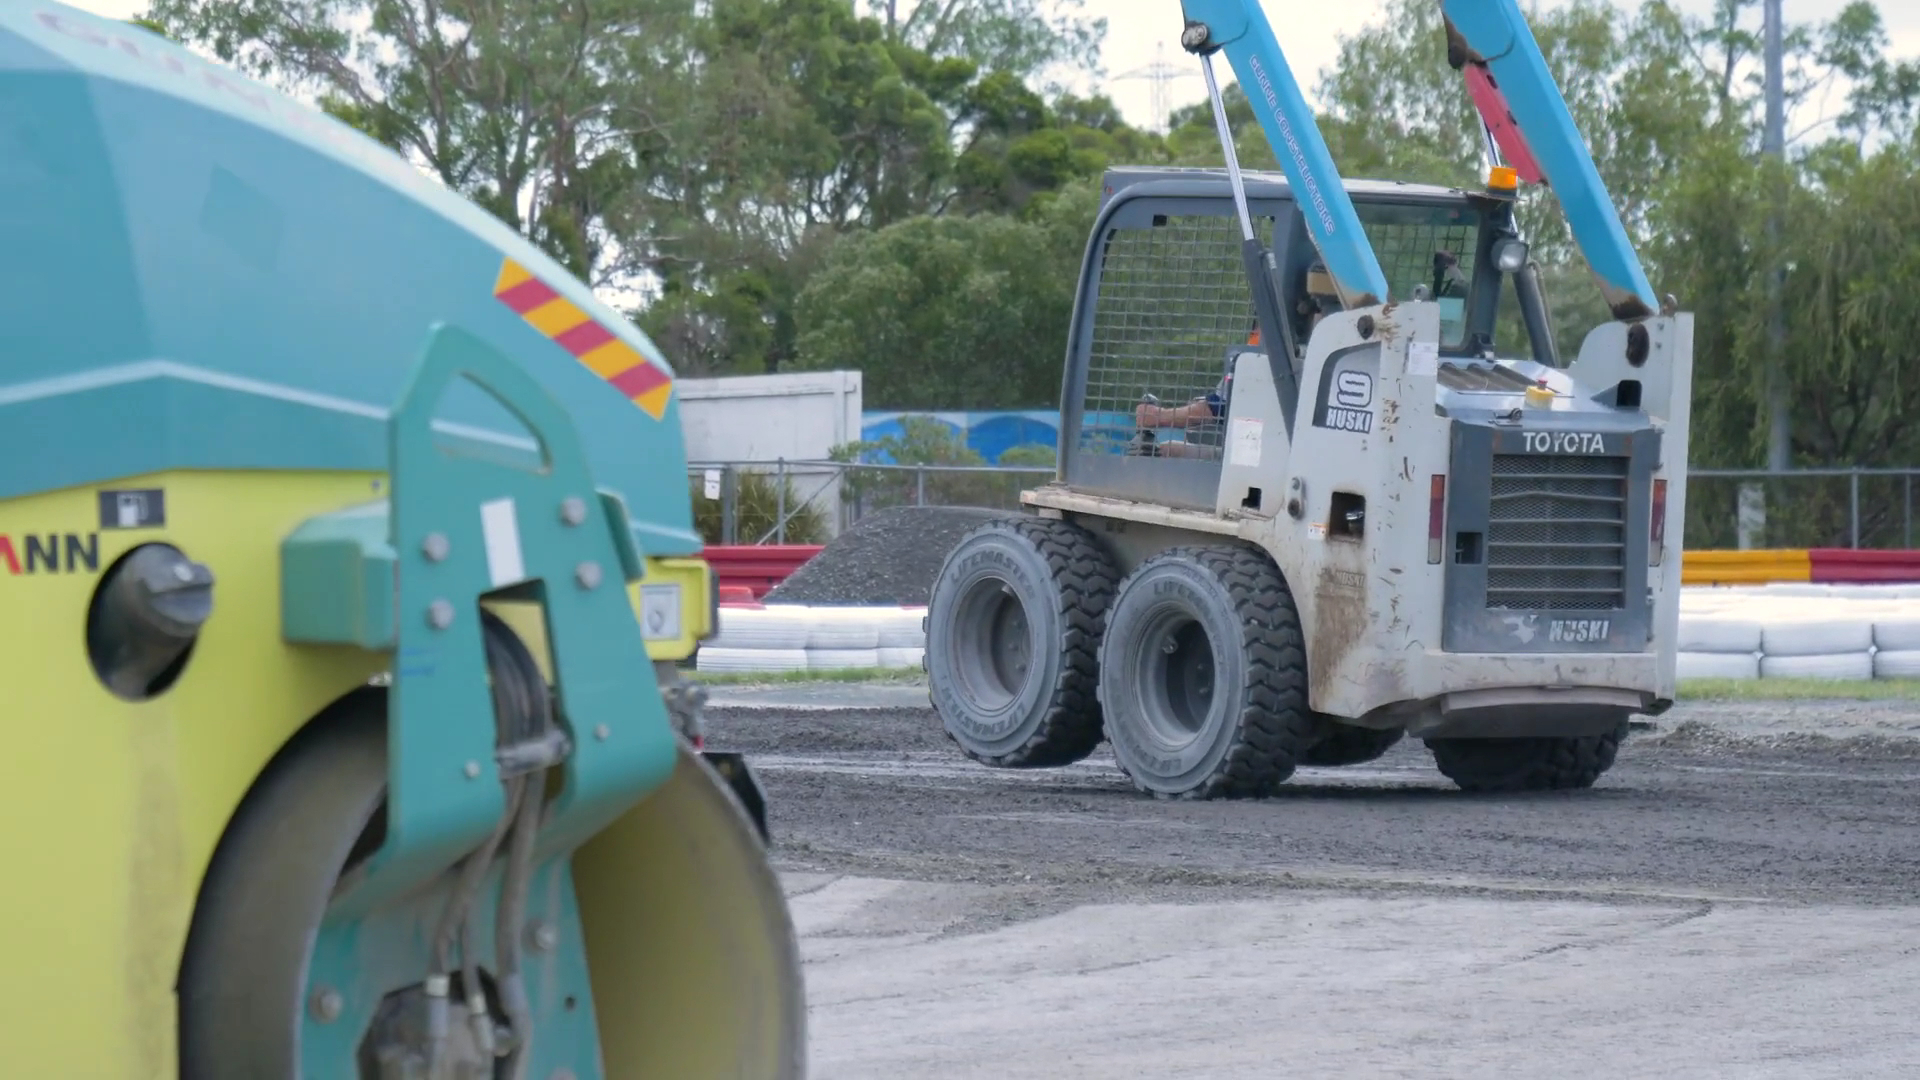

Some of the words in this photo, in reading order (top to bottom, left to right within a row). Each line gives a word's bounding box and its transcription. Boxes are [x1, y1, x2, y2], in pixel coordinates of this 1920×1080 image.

[1250, 54, 1277, 109] GUNNE
[1274, 108, 1336, 237] CONSTRUCTIONS
[1326, 407, 1373, 433] HUSKI
[1522, 431, 1605, 454] TOYOTA
[1549, 619, 1610, 642] HUSKI
